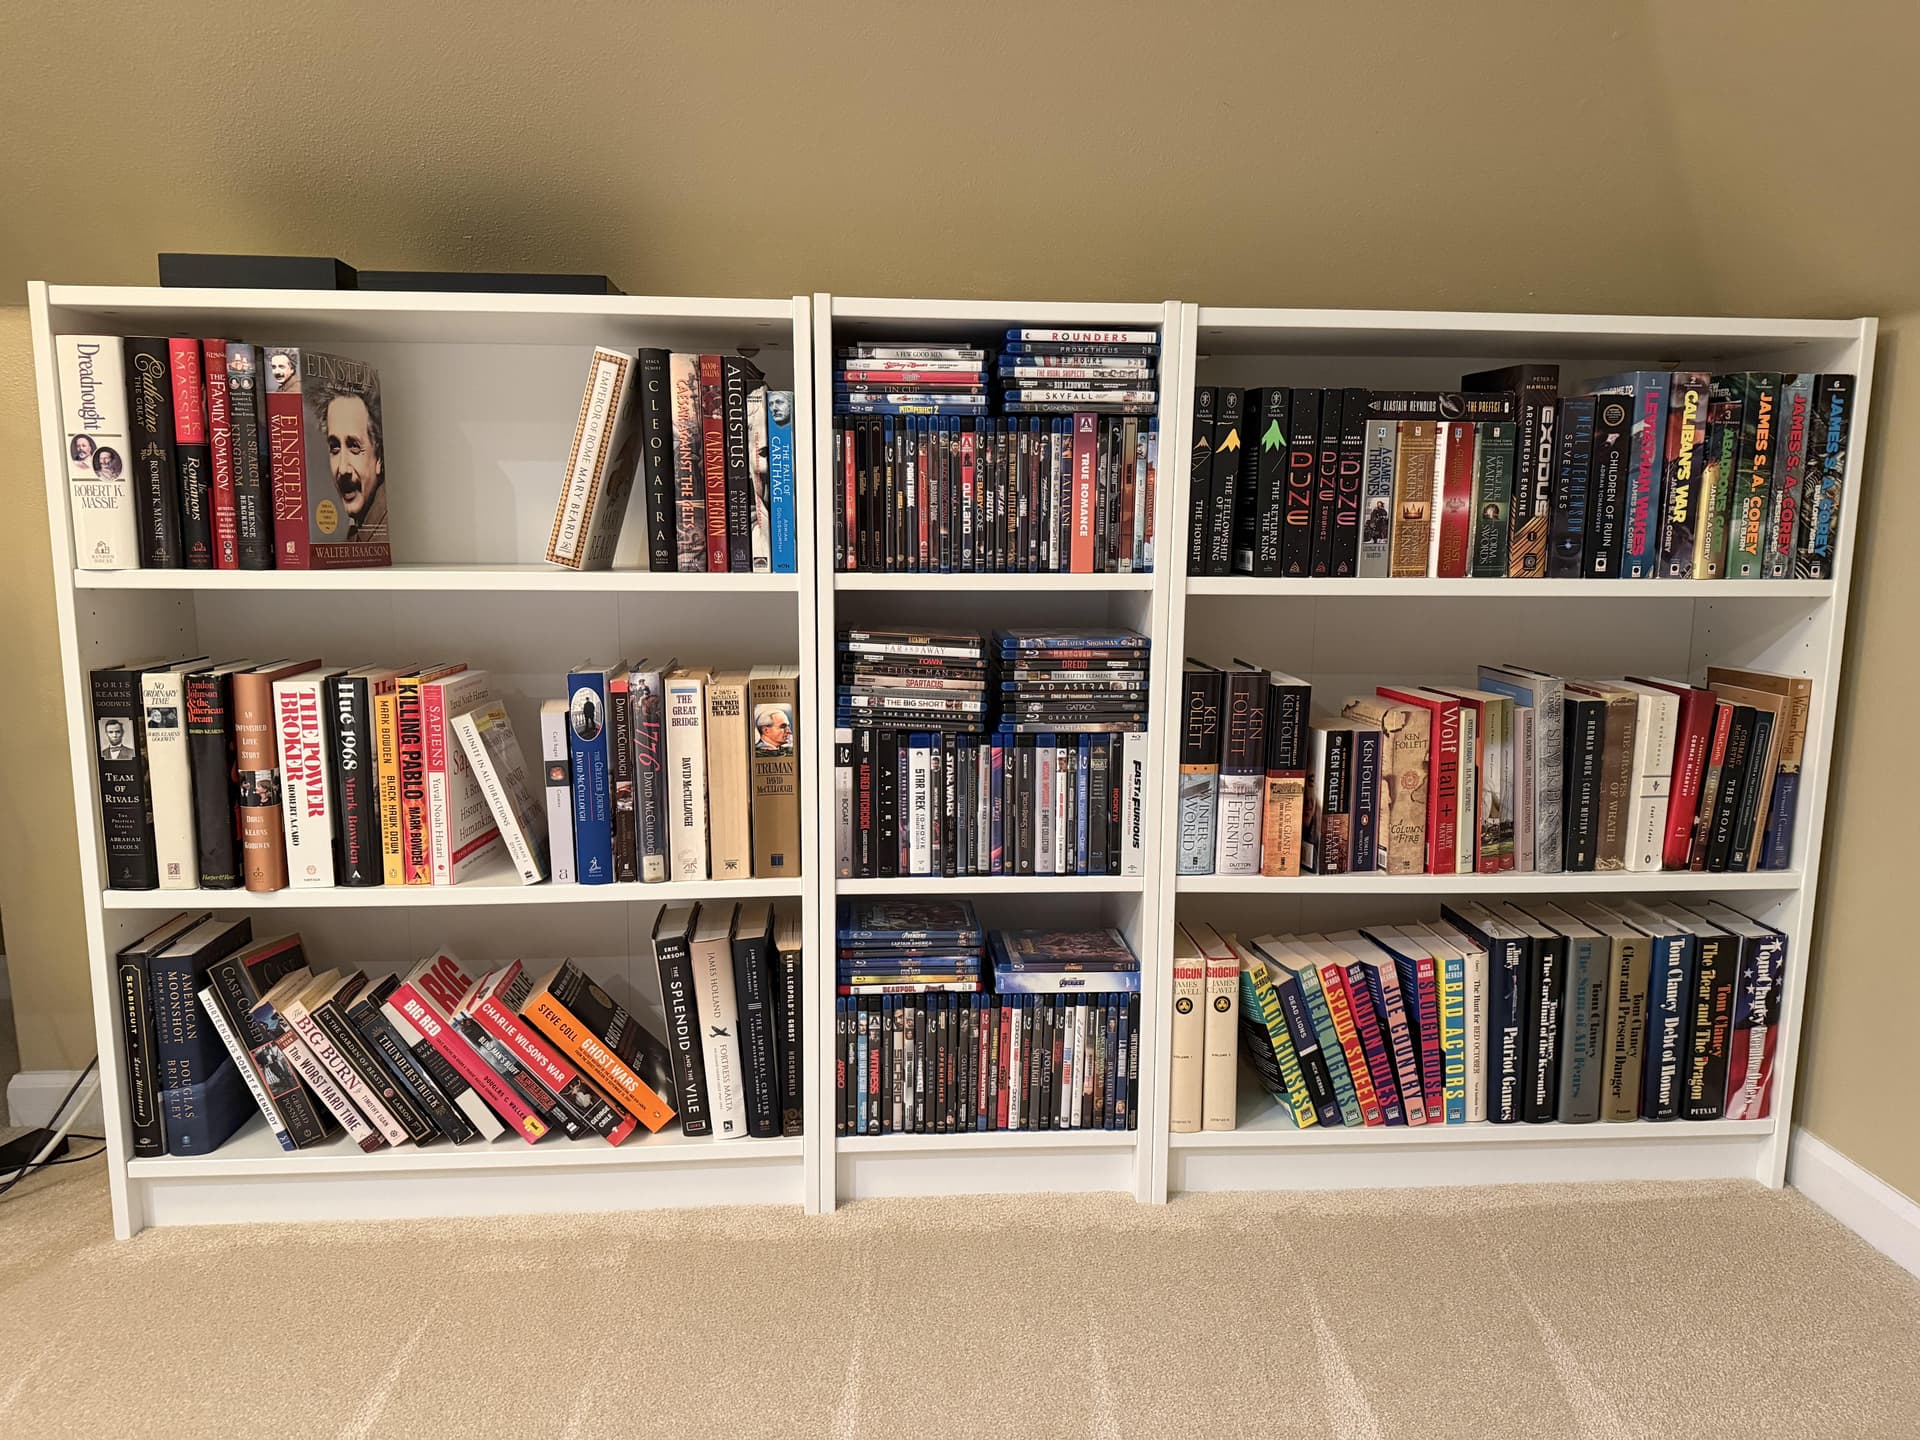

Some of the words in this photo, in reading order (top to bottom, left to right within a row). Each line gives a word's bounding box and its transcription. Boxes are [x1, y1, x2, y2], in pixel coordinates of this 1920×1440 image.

[1052, 333, 1128, 342] ROUNDERS
[77, 344, 105, 430] Dreadnought
[135, 353, 165, 433] Catherine
[210, 382, 225, 423] FAMILY
[594, 371, 611, 420] EMPEROR
[1383, 400, 1408, 412] ALASTAIR
[1409, 400, 1436, 412] REYNOLDS
[728, 365, 745, 468] AUGUSTUS
[1755, 392, 1773, 451] JAMES
[213, 425, 230, 491] ROMANOV
[271, 414, 281, 465] WALTER
[581, 436, 596, 463] ROME
[1522, 405, 1534, 473] ARCHIMEDES
[279, 414, 303, 521] EINSTEIN
[648, 381, 665, 541] CLEOPATRA
[771, 437, 783, 503] CARTHAGE
[1080, 453, 1089, 480] TRUE
[1319, 451, 1336, 501] DUNE
[1368, 450, 1381, 495] THRONES
[1535, 406, 1554, 517] EXODUS
[1559, 434, 1573, 510] SEVENEVES
[1753, 455, 1767, 470] S.
[74, 485, 112, 497] ROBERT
[113, 484, 125, 497] K.
[188, 456, 200, 520] Romanovs
[273, 468, 285, 521] ISAACSON
[574, 467, 588, 500] MARY
[1225, 475, 1233, 495] THE
[1287, 452, 1312, 526] DUNE
[1336, 461, 1360, 526] DUNE
[1519, 478, 1528, 517] ENGINE
[1752, 475, 1764, 492] A.
[81, 497, 119, 509] MASSIE
[563, 503, 580, 540] BEARD
[986, 491, 994, 522] DRIVE
[1080, 483, 1088, 537] ROMANCE
[1673, 485, 1689, 523] WAR
[1193, 522, 1202, 562] HOBBIT
[1220, 497, 1232, 562] FELLOWSHIP
[1746, 497, 1762, 555] COREY
[1778, 498, 1795, 556] COREY
[1261, 535, 1269, 561] KING
[905, 679, 943, 688] SPARTACUS
[1062, 661, 1088, 669] DREDD
[143, 689, 178, 697] ORDINARY
[151, 697, 169, 705] TIME
[187, 680, 214, 690] Lyndon
[188, 715, 213, 724] Dream
[380, 701, 390, 725] MARK
[399, 685, 420, 745] KILLING
[672, 706, 697, 715] GREAT
[672, 717, 699, 727] BRIDGE
[1188, 691, 1205, 750] FOLLETT
[1203, 706, 1216, 735] KEN
[1281, 694, 1294, 718] KEN
[281, 692, 304, 782] BROKER
[381, 728, 392, 764] BOWDEN
[430, 705, 443, 767] SAPIENS
[633, 721, 661, 772] 1776
[1279, 721, 1292, 767] FOLLETT
[1441, 706, 1458, 753] Wolf
[1587, 720, 1595, 750] HERMAN
[341, 730, 358, 770] 1968
[756, 763, 792, 773] TRUMAN
[946, 752, 954, 780] STAR
[1330, 749, 1341, 769] KEN
[1362, 739, 1375, 763] KEN
[1583, 754, 1593, 776] WOUK
[105, 773, 134, 782] TEAM
[344, 776, 358, 810] Mark
[387, 776, 396, 801] BLACK
[402, 750, 424, 800] PABLO
[432, 778, 442, 800] Yuval
[915, 769, 925, 789] STAR
[1328, 771, 1339, 813] FOLLETT
[1360, 765, 1374, 812] FOLLETT
[1439, 761, 1456, 798] Hall
[1727, 779, 1736, 805] THE
[105, 795, 140, 803] RIVALS
[388, 805, 398, 829] HAWK
[434, 803, 443, 825] Noah
[915, 791, 925, 810] TREK
[946, 782, 954, 816] WARS
[1113, 813, 1118, 823] IV
[1243, 795, 1258, 828] EDGE
[347, 815, 359, 865] Bowden
[1133, 796, 1141, 848] FURIOUS
[1226, 801, 1242, 859] ETERNITY
[1607, 799, 1618, 843] WRATH
[1717, 808, 1730, 843] ROAD
[390, 830, 399, 855] DOWN
[436, 828, 445, 859] Harari
[1242, 833, 1254, 849] OF
[659, 951, 685, 961] LARSON
[1701, 942, 1718, 966] The
[1383, 985, 1402, 1018] JOE
[1445, 982, 1464, 1019] BAD
[1700, 970, 1716, 1000] Bear
[1716, 984, 1731, 1012] Tom
[126, 975, 137, 1035] SEABISCUIT
[167, 971, 184, 1044] MOONSHOT
[181, 973, 198, 1040] AMERICAN
[402, 999, 425, 1023] BIG
[420, 1016, 442, 1037] RED
[538, 1003, 560, 1026] STEVE
[559, 1023, 578, 1042] COLL
[670, 981, 690, 1051] SPLENDID
[1288, 995, 1299, 1015] DEAD
[1295, 1018, 1307, 1039] LIONS
[1418, 982, 1438, 1041] SLOUGH
[1697, 1003, 1710, 1026] and
[296, 1015, 324, 1046] BIG
[482, 1003, 517, 1037] CHARLIE
[514, 1032, 547, 1067] WILSON'S
[545, 1064, 565, 1083] WAR
[1696, 1028, 1712, 1053] The
[1709, 1015, 1729, 1057] Clancy
[321, 1044, 361, 1091] BURN
[581, 1038, 615, 1067] GHOST
[609, 1063, 639, 1092] WARS
[1390, 1022, 1422, 1100] COUNTRY
[1445, 1028, 1464, 1099] ACTORS
[1503, 1027, 1518, 1074] Patriot
[378, 1034, 439, 1108] THUNDERSTRUCK
[837, 1059, 845, 1089] ARGO
[870, 1049, 880, 1095] WITNESS
[1423, 1050, 1441, 1099] HOUSE
[1688, 1056, 1708, 1100] Dragon
[685, 1083, 700, 1114] VILE
[1501, 1077, 1517, 1120] Games
